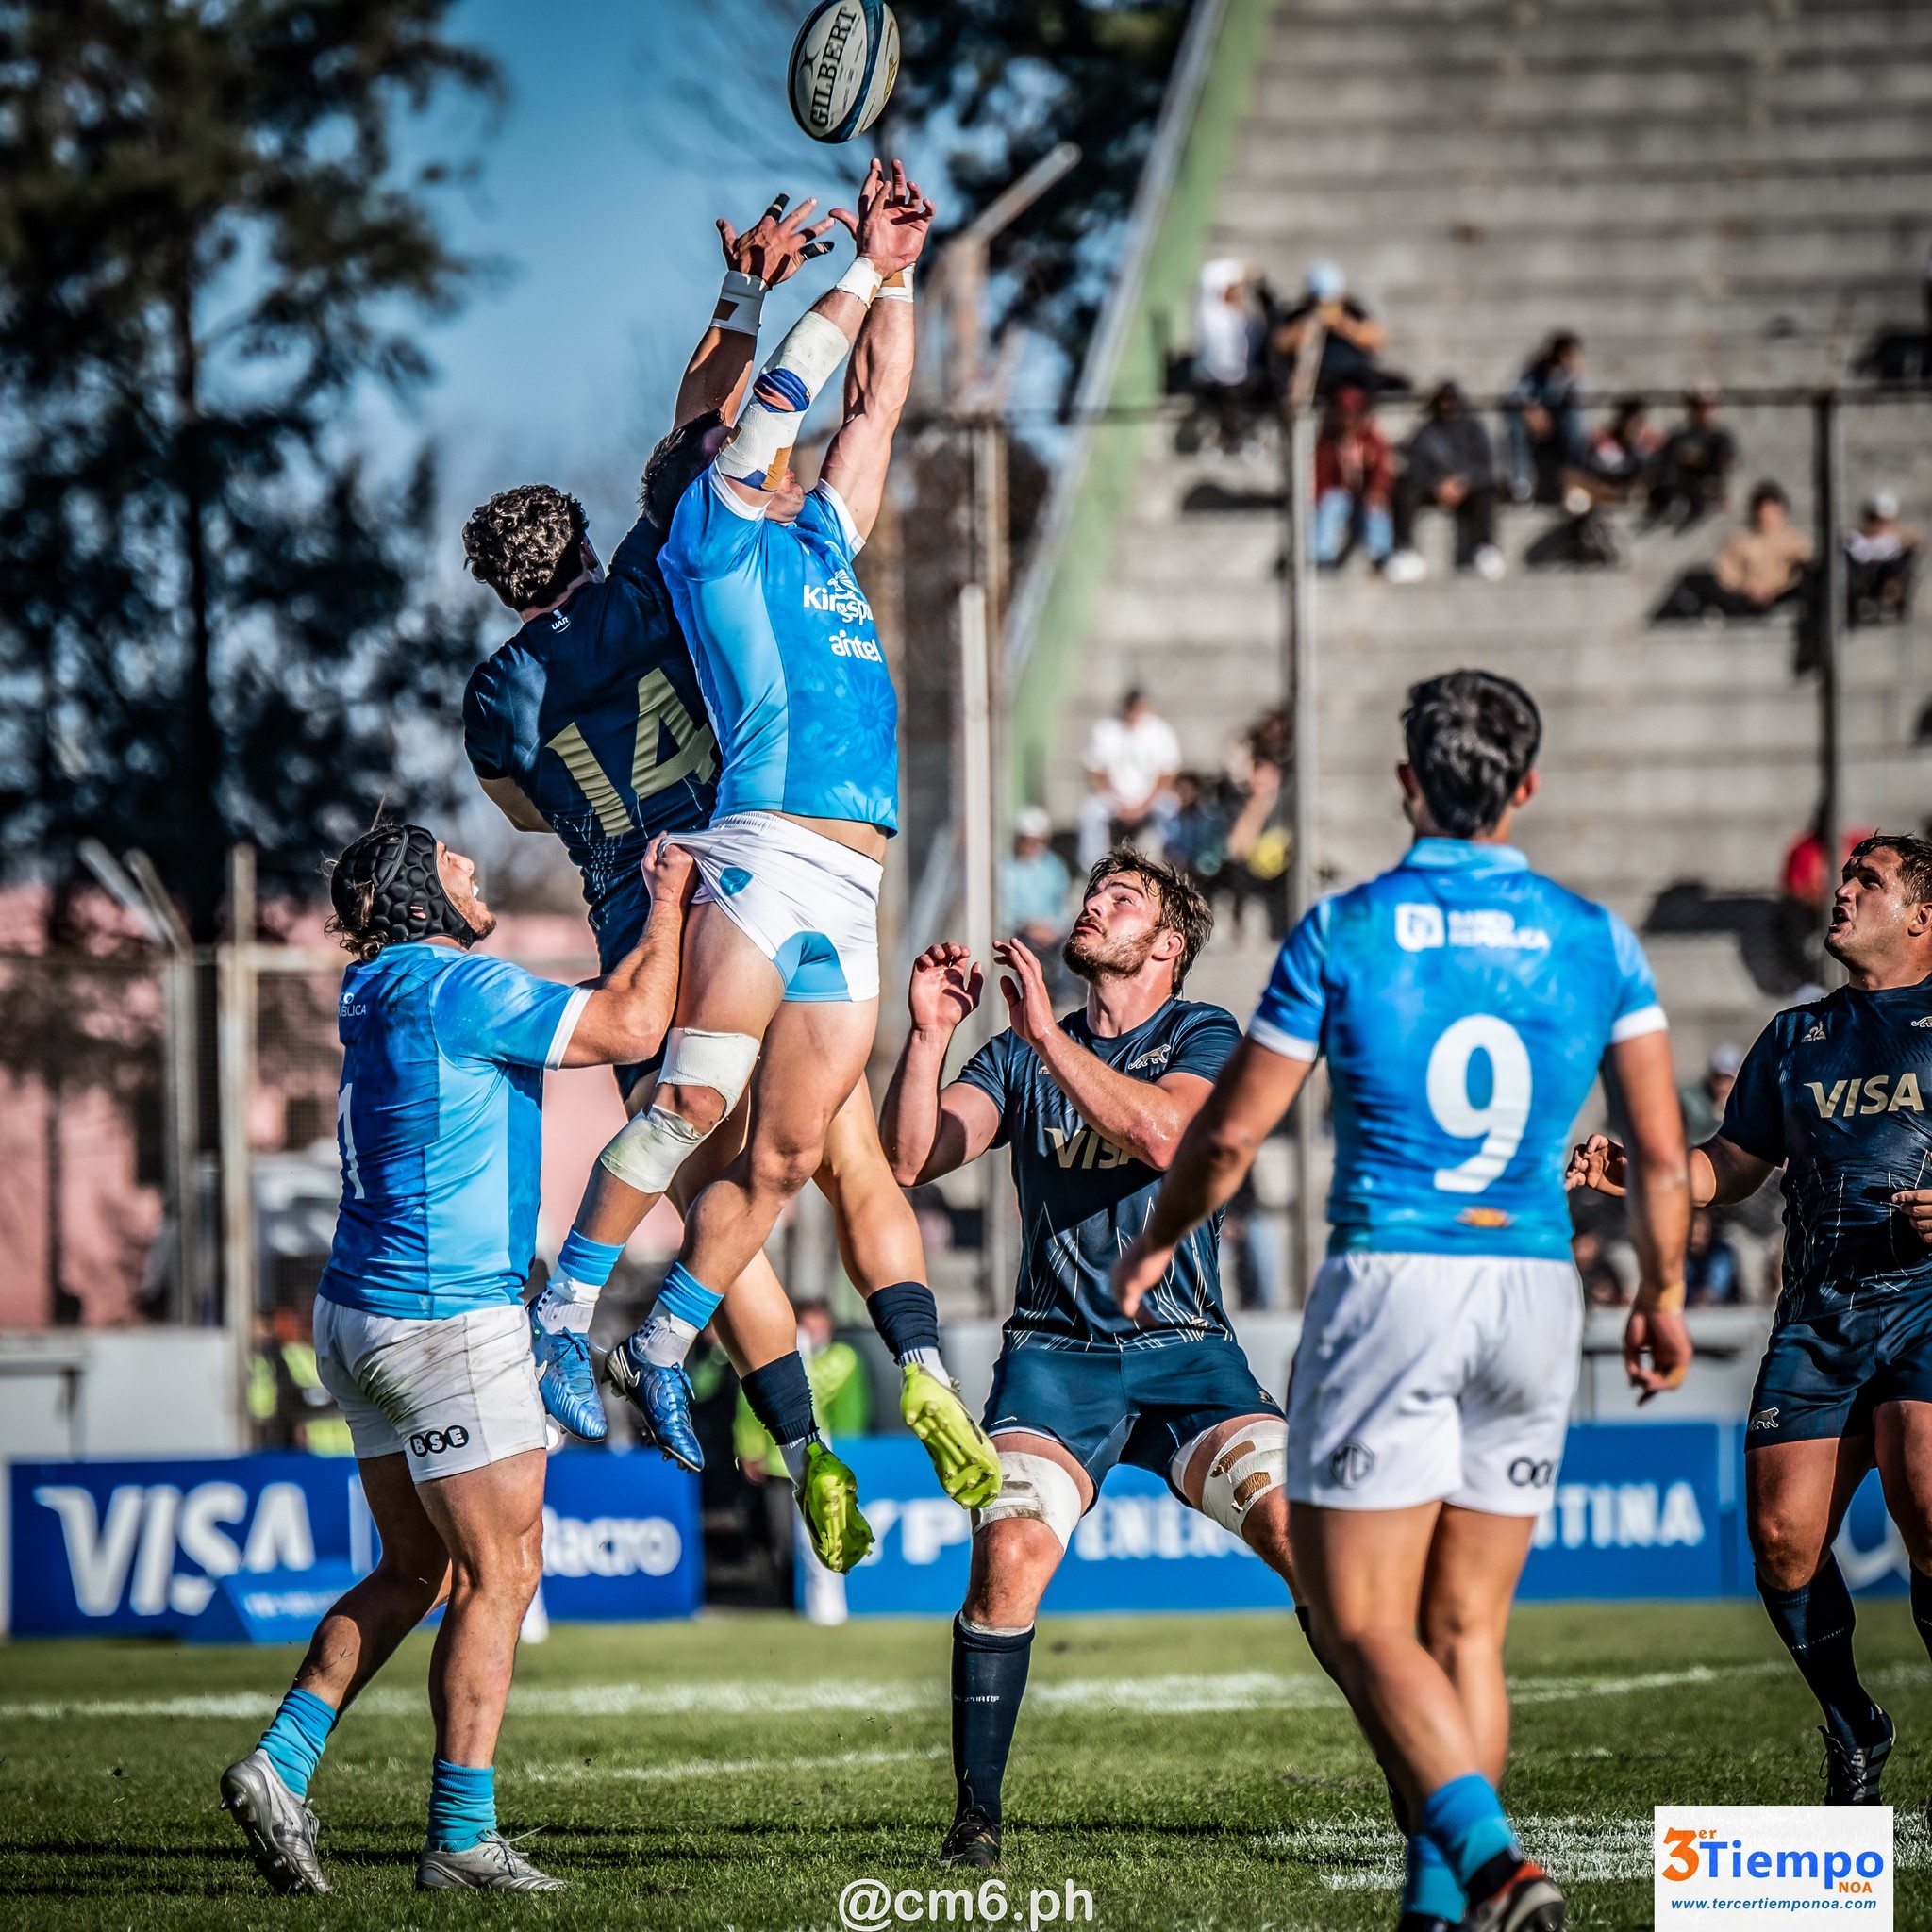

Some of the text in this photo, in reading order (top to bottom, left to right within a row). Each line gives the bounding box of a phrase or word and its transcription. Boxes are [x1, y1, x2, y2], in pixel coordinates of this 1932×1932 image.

[809, 7, 858, 127] GILBERT
[552, 616, 569, 629] UAR
[829, 629, 883, 663] antel
[545, 667, 715, 837] 14
[1425, 1013, 1533, 1193] 9
[1804, 1073, 1924, 1118] VISA
[1044, 1127, 1135, 1169] VIS
[410, 1425, 469, 1457] BSE
[36, 1481, 316, 1616] VISA
